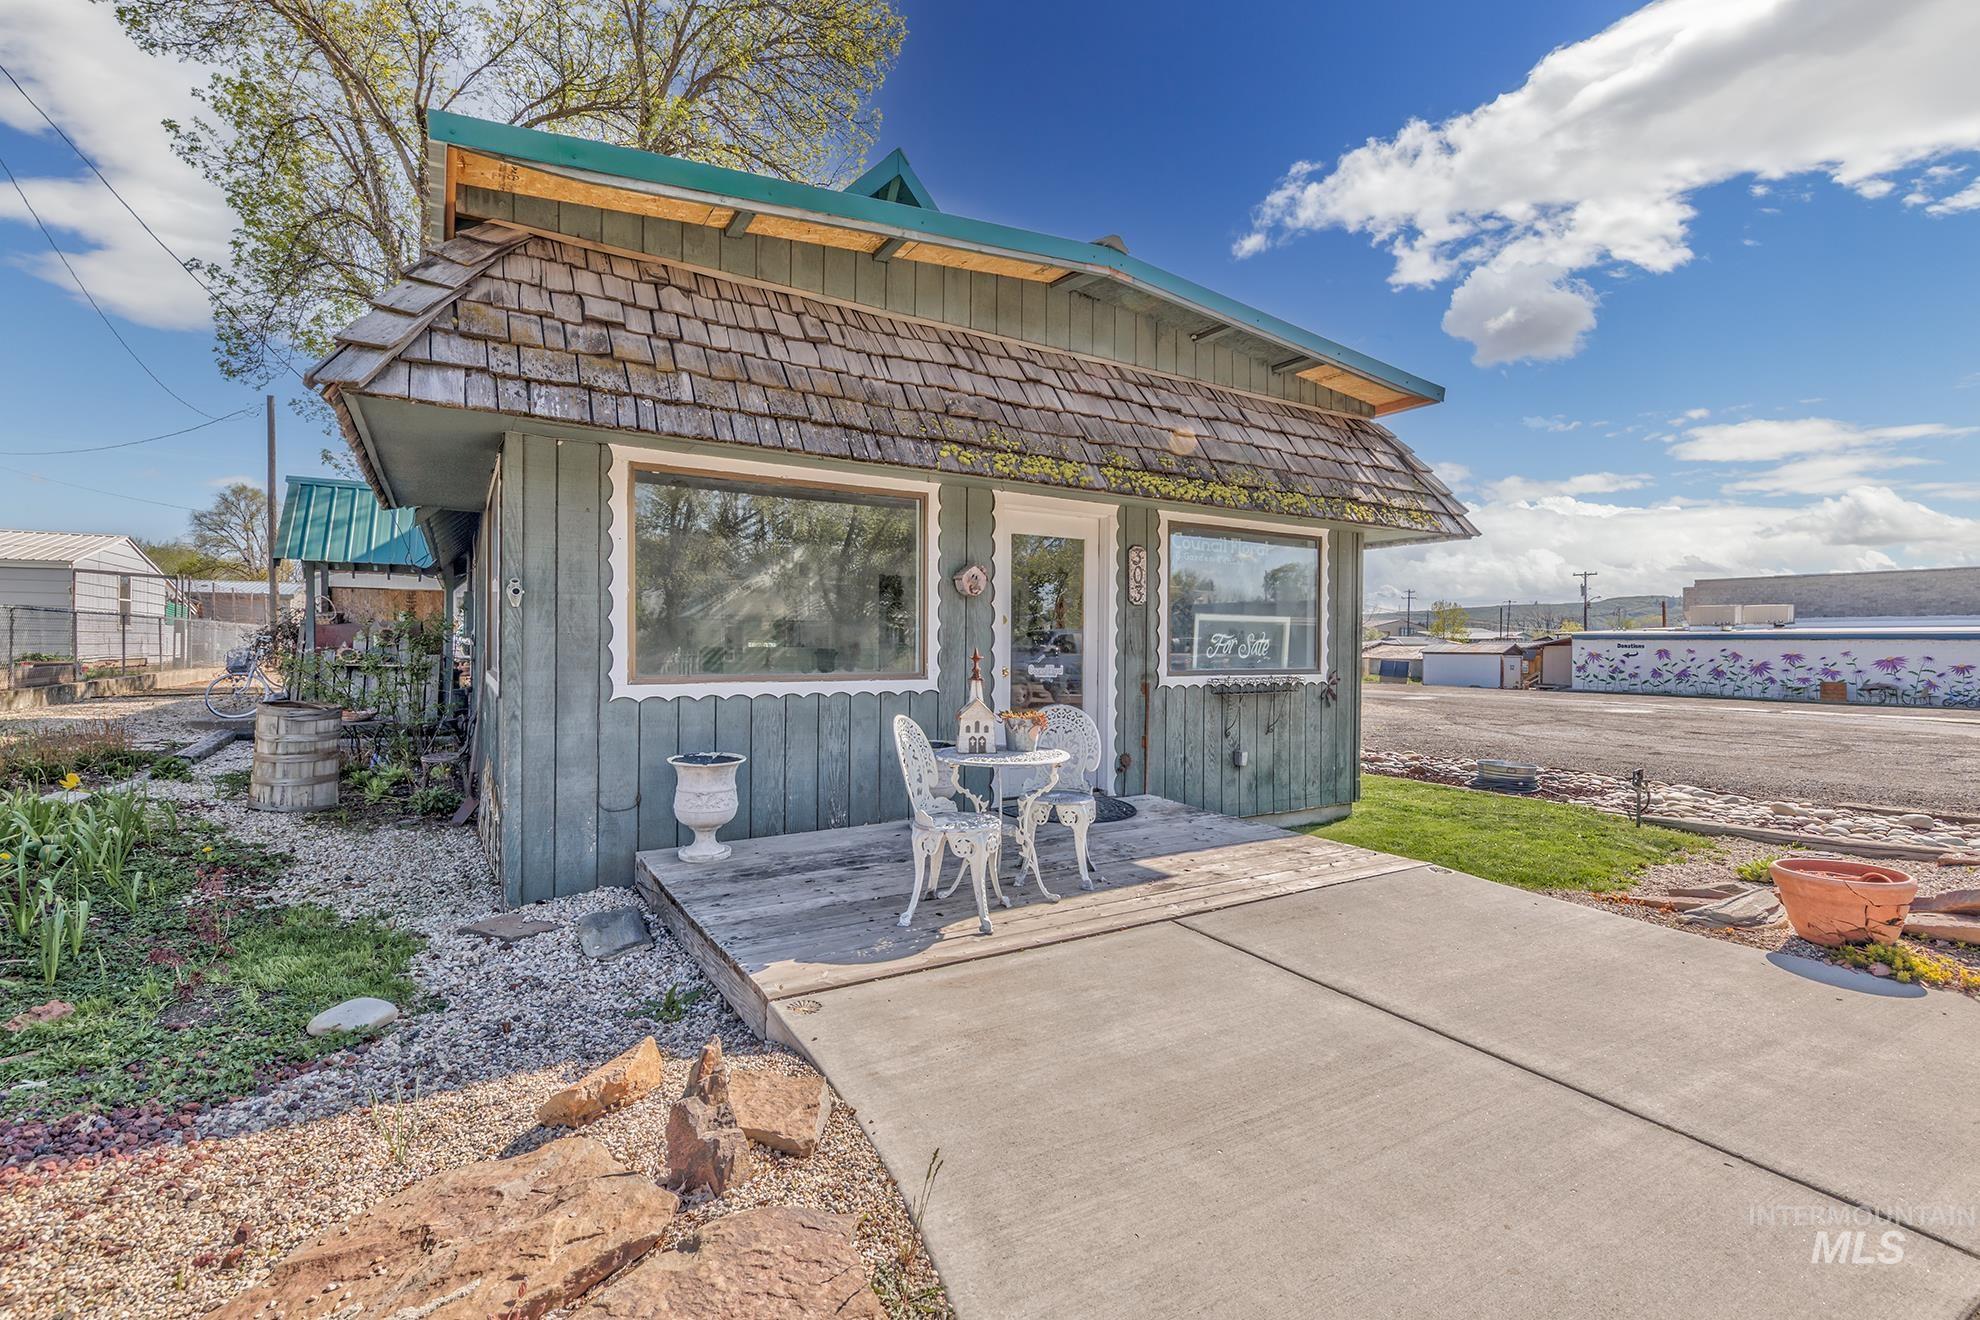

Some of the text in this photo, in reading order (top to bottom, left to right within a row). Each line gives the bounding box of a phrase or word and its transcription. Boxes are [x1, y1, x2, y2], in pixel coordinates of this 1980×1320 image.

[1172, 532, 1228, 553] Council
[1130, 547, 1144, 602] 303
[1206, 633, 1238, 659] For
